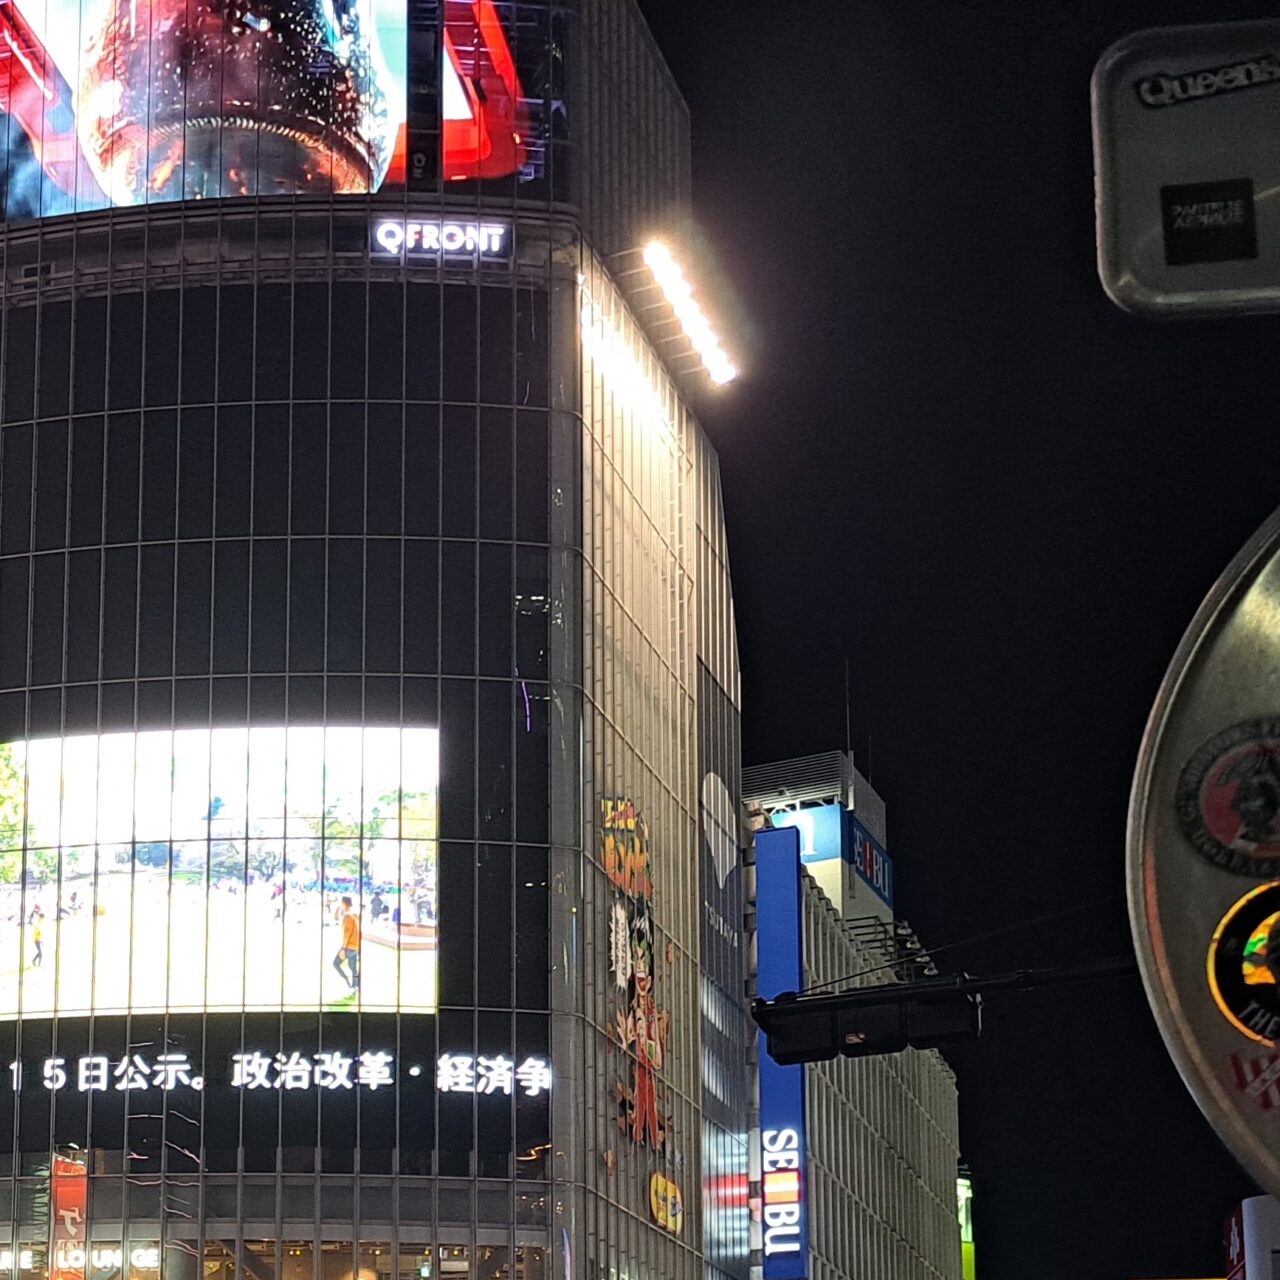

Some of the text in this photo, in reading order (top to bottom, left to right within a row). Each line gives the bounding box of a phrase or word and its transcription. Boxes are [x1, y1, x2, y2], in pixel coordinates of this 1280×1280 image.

[377, 223, 504, 254] QFRONT
[763, 1128, 801, 1257] SEIBU
[58, 1250, 159, 1270] LOUNGE
